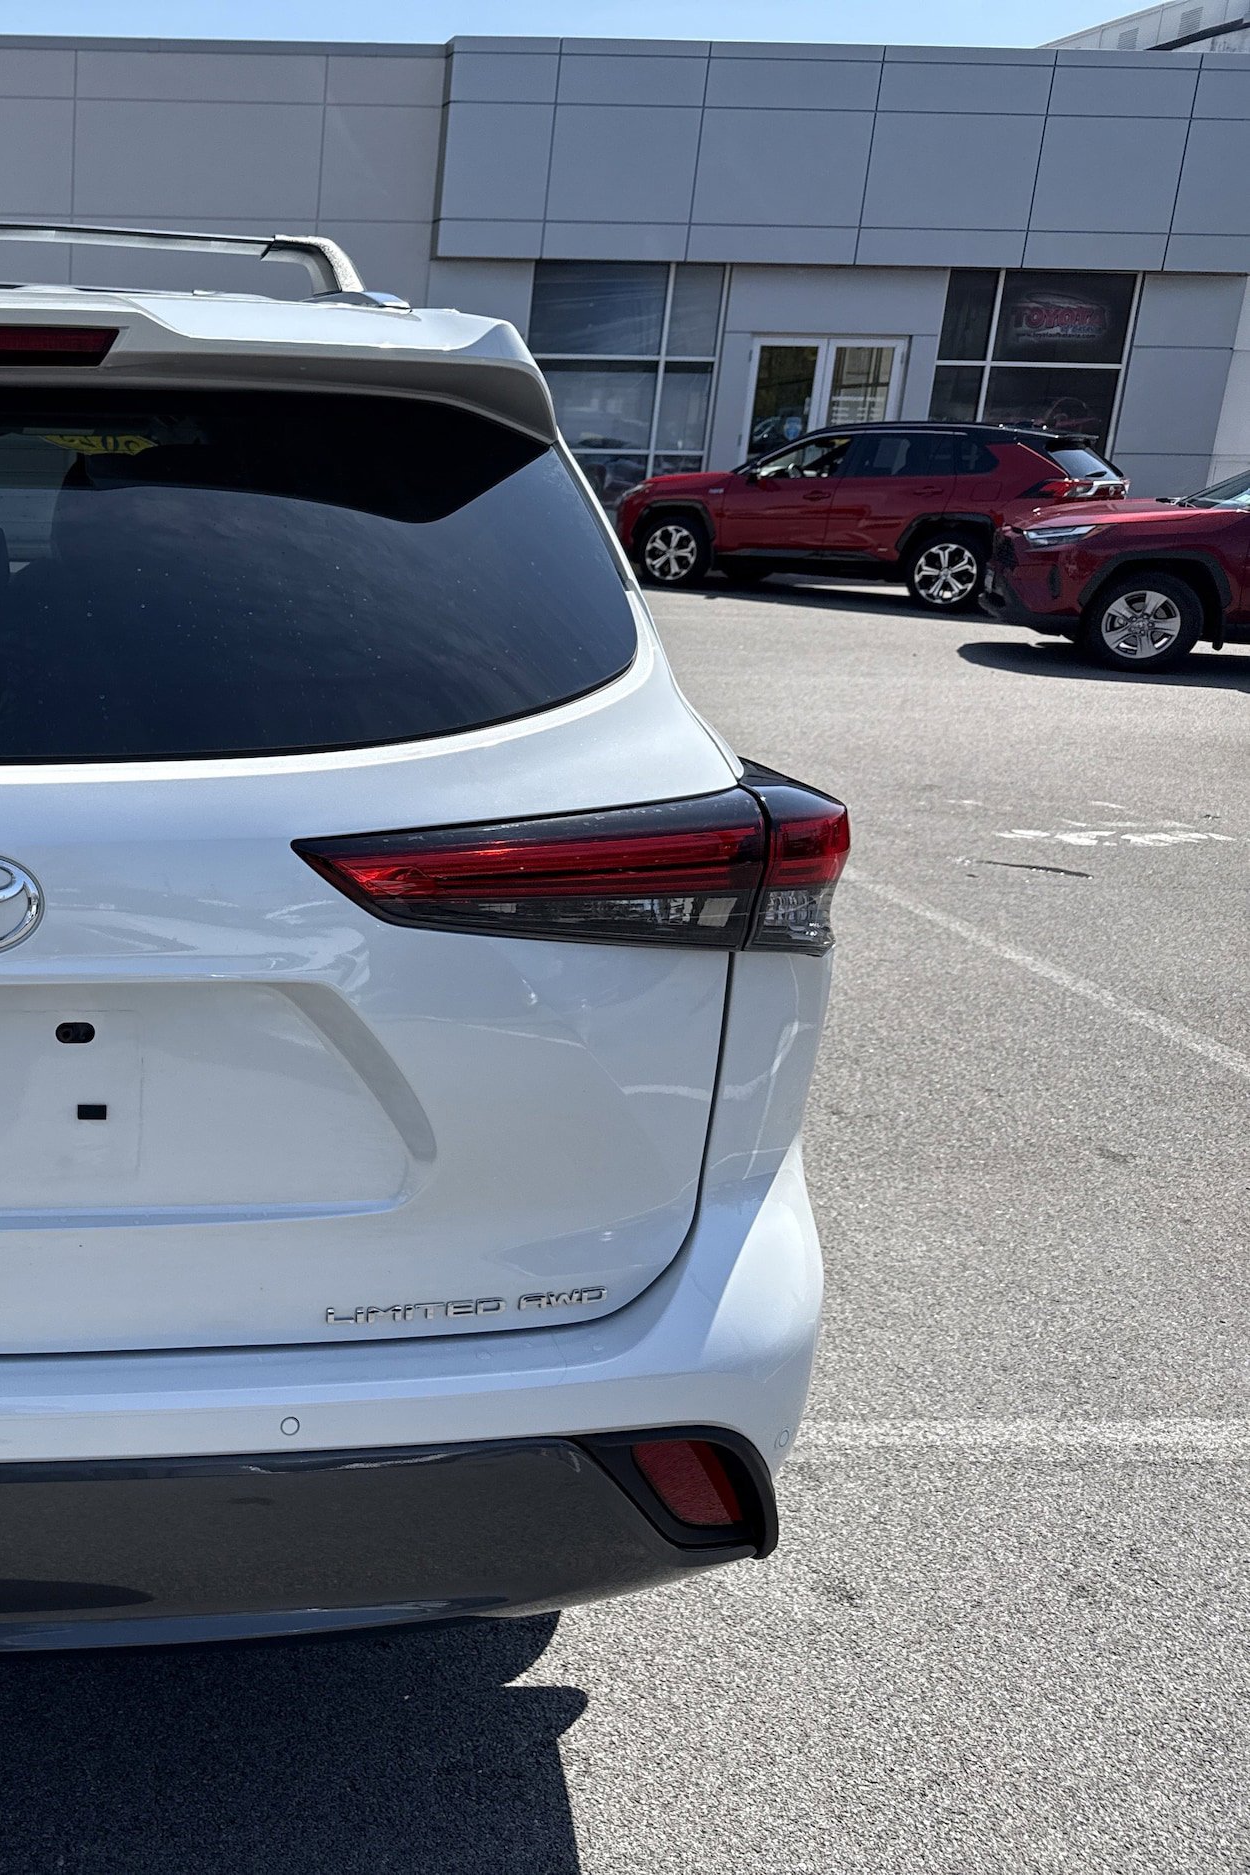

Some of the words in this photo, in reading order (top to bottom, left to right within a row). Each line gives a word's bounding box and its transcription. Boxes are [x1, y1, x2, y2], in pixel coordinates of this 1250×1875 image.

[1012, 305, 1105, 328] TOYOTA
[325, 1296, 506, 1326] LIMITED
[518, 1285, 608, 1312] AWD
